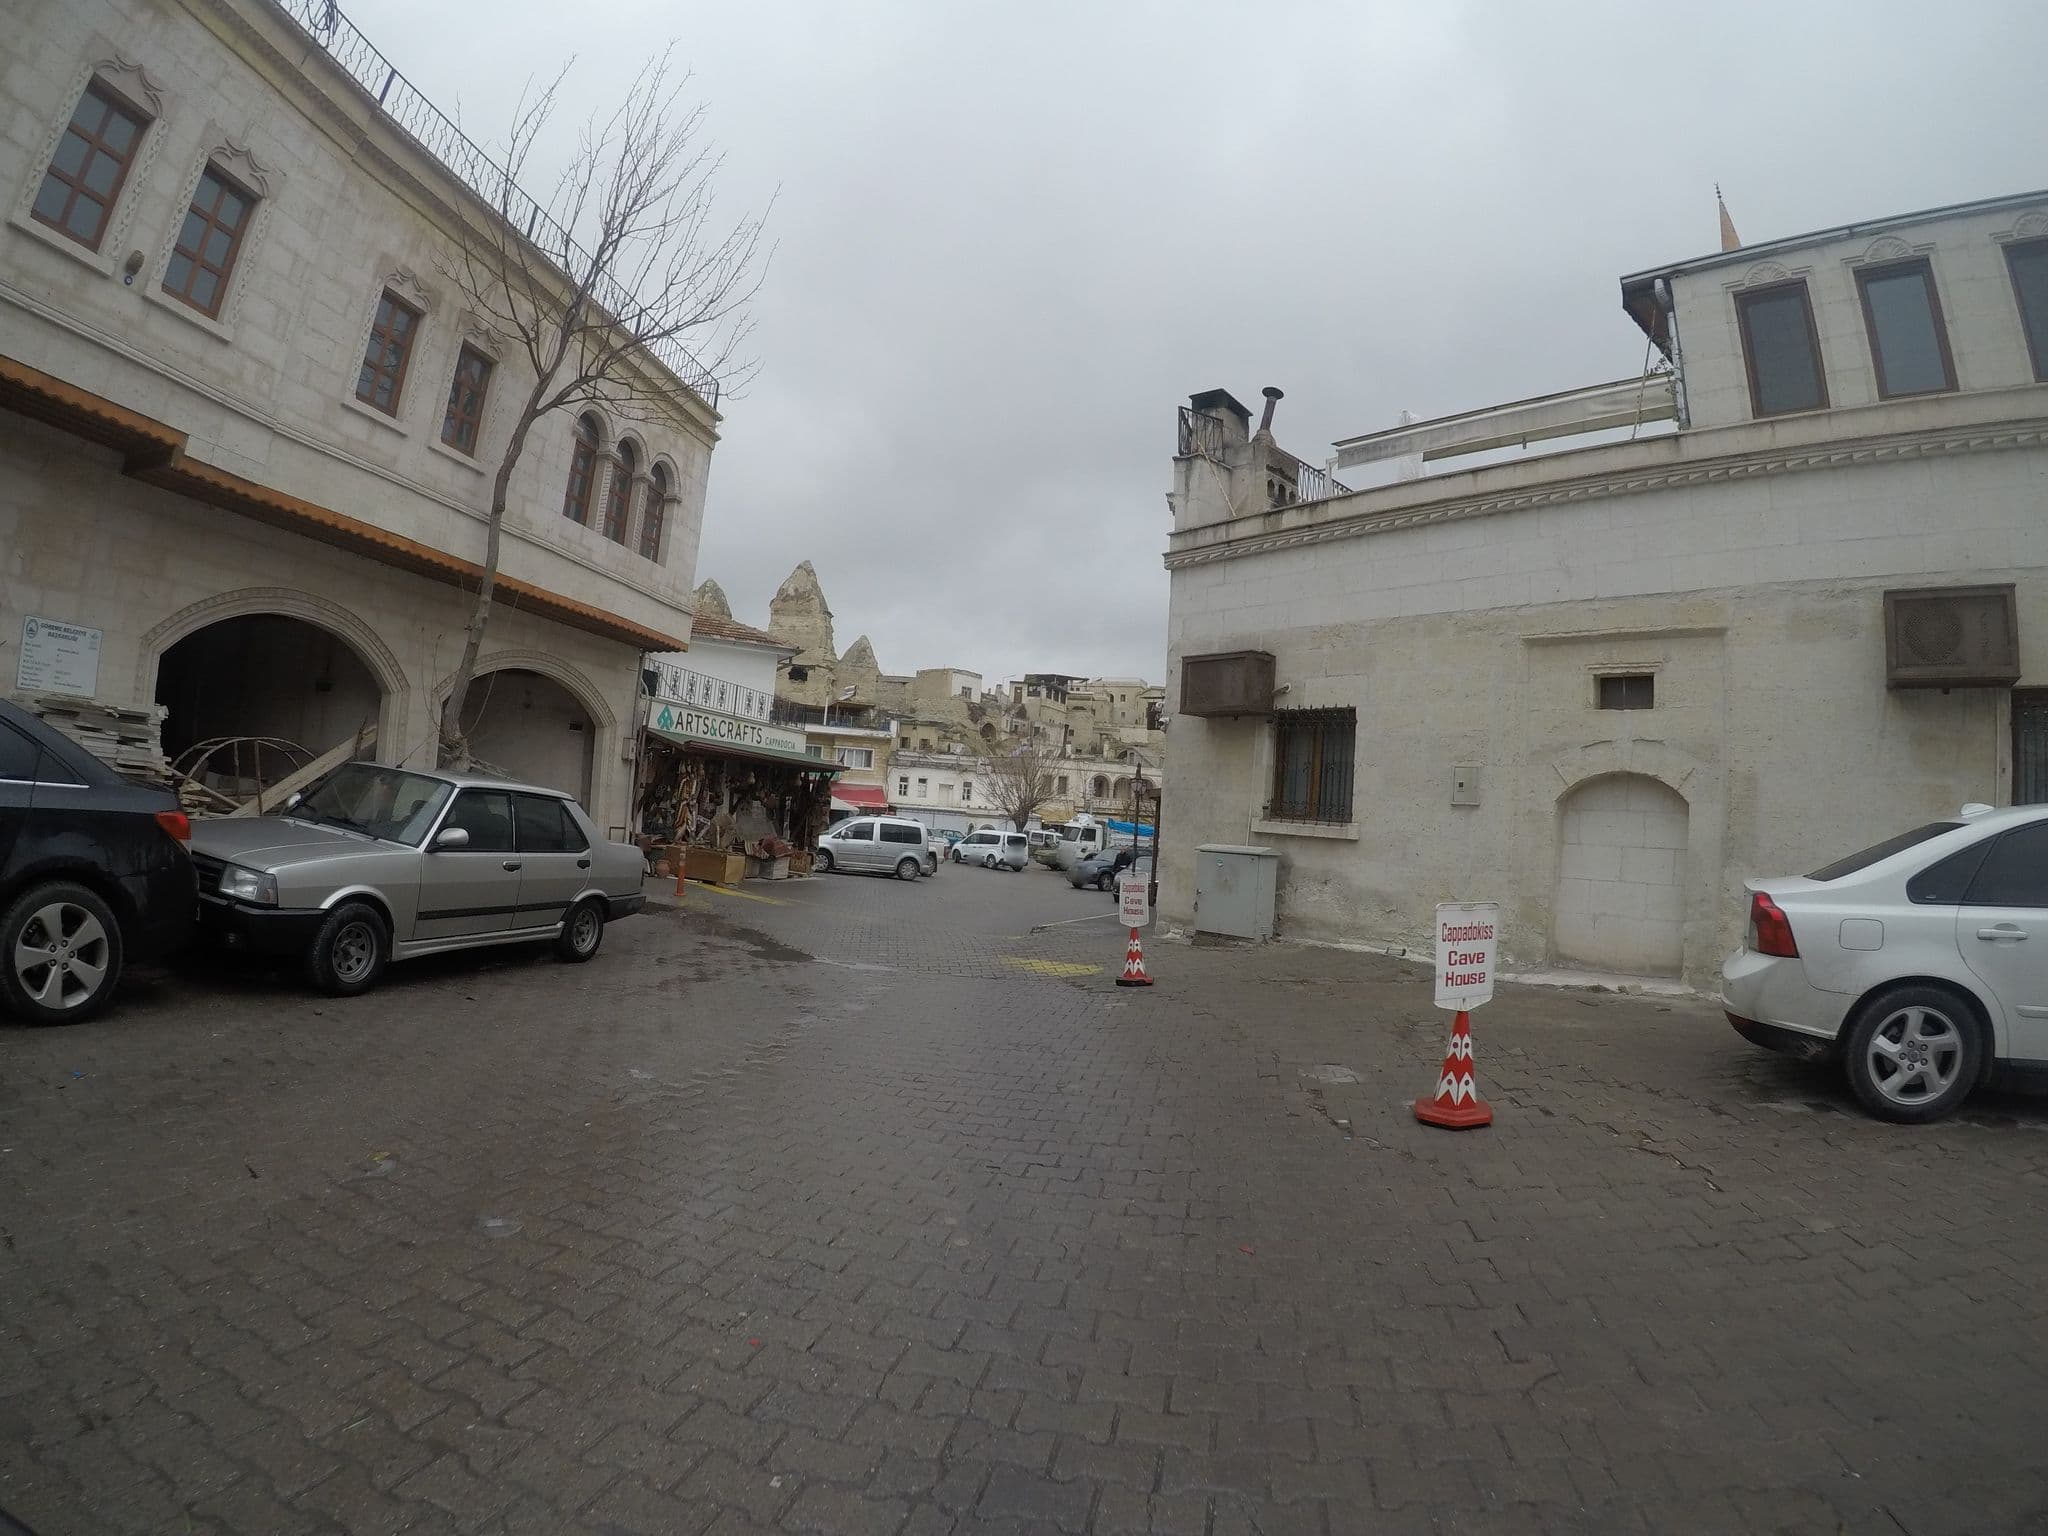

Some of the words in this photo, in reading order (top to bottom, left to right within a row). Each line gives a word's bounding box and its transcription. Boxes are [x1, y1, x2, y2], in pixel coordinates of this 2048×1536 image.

[765, 736, 796, 750] CAPPADOCIA
[1442, 921, 1494, 946] Cappadokiss
[1448, 950, 1485, 966] Cave
[1445, 971, 1487, 988] House
